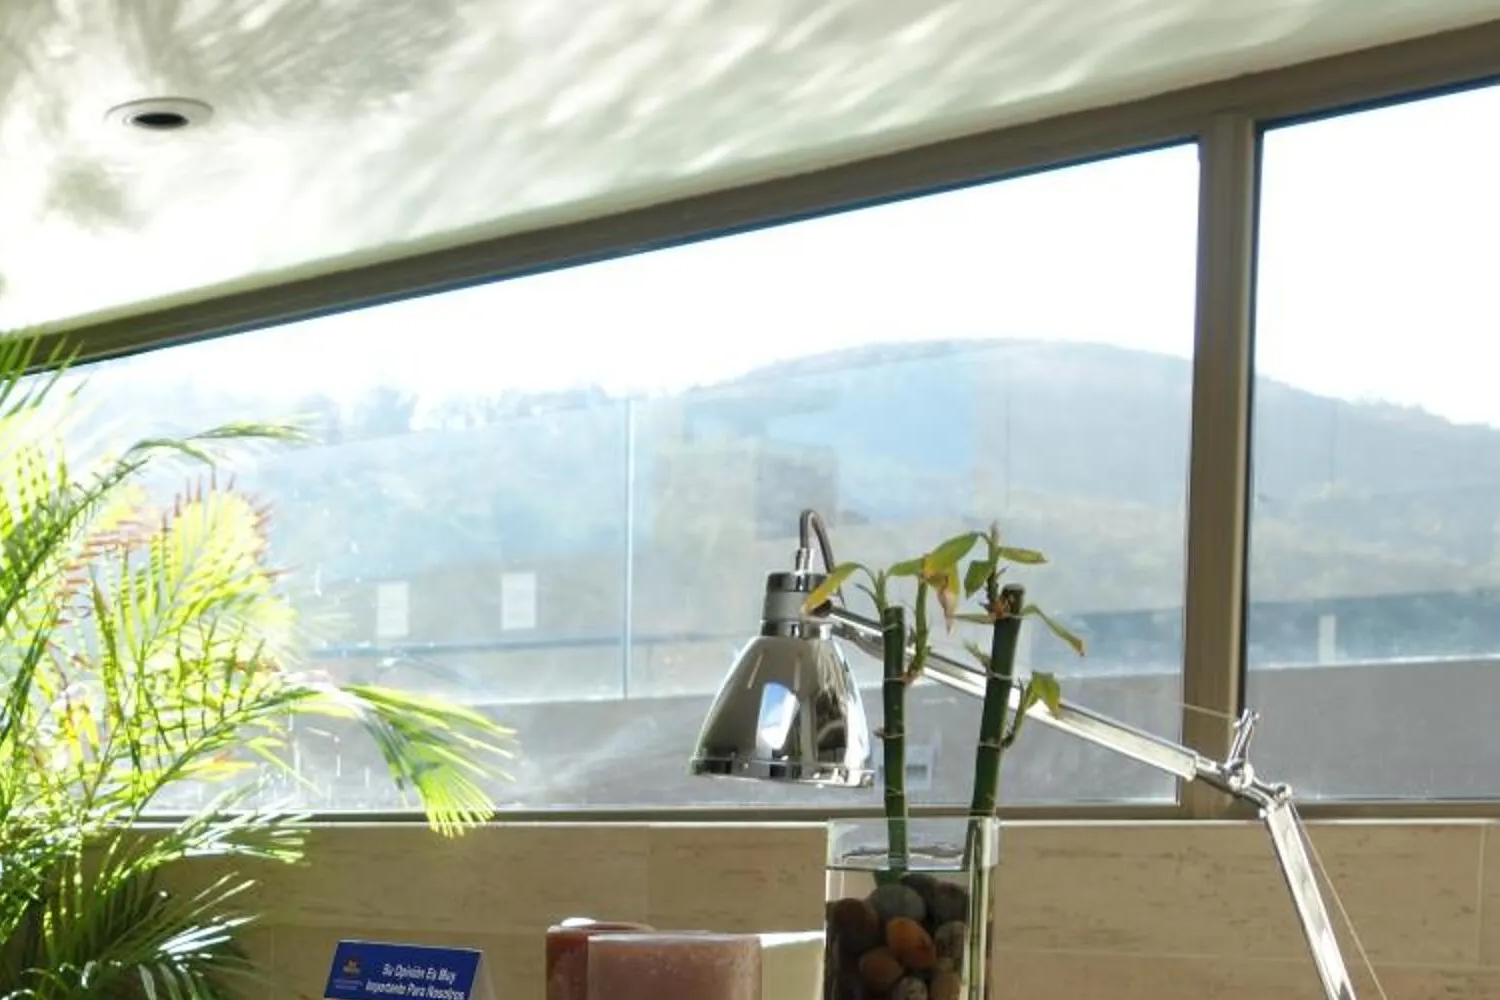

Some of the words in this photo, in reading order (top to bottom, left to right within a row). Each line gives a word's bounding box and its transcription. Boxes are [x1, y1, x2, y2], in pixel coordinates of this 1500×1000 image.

[382, 963, 393, 976] Su
[426, 967, 437, 980] Es
[438, 968, 457, 984] Muy
[365, 980, 406, 995] Importante
[407, 983, 426, 997] Para
[427, 985, 465, 1000] Nosotros
